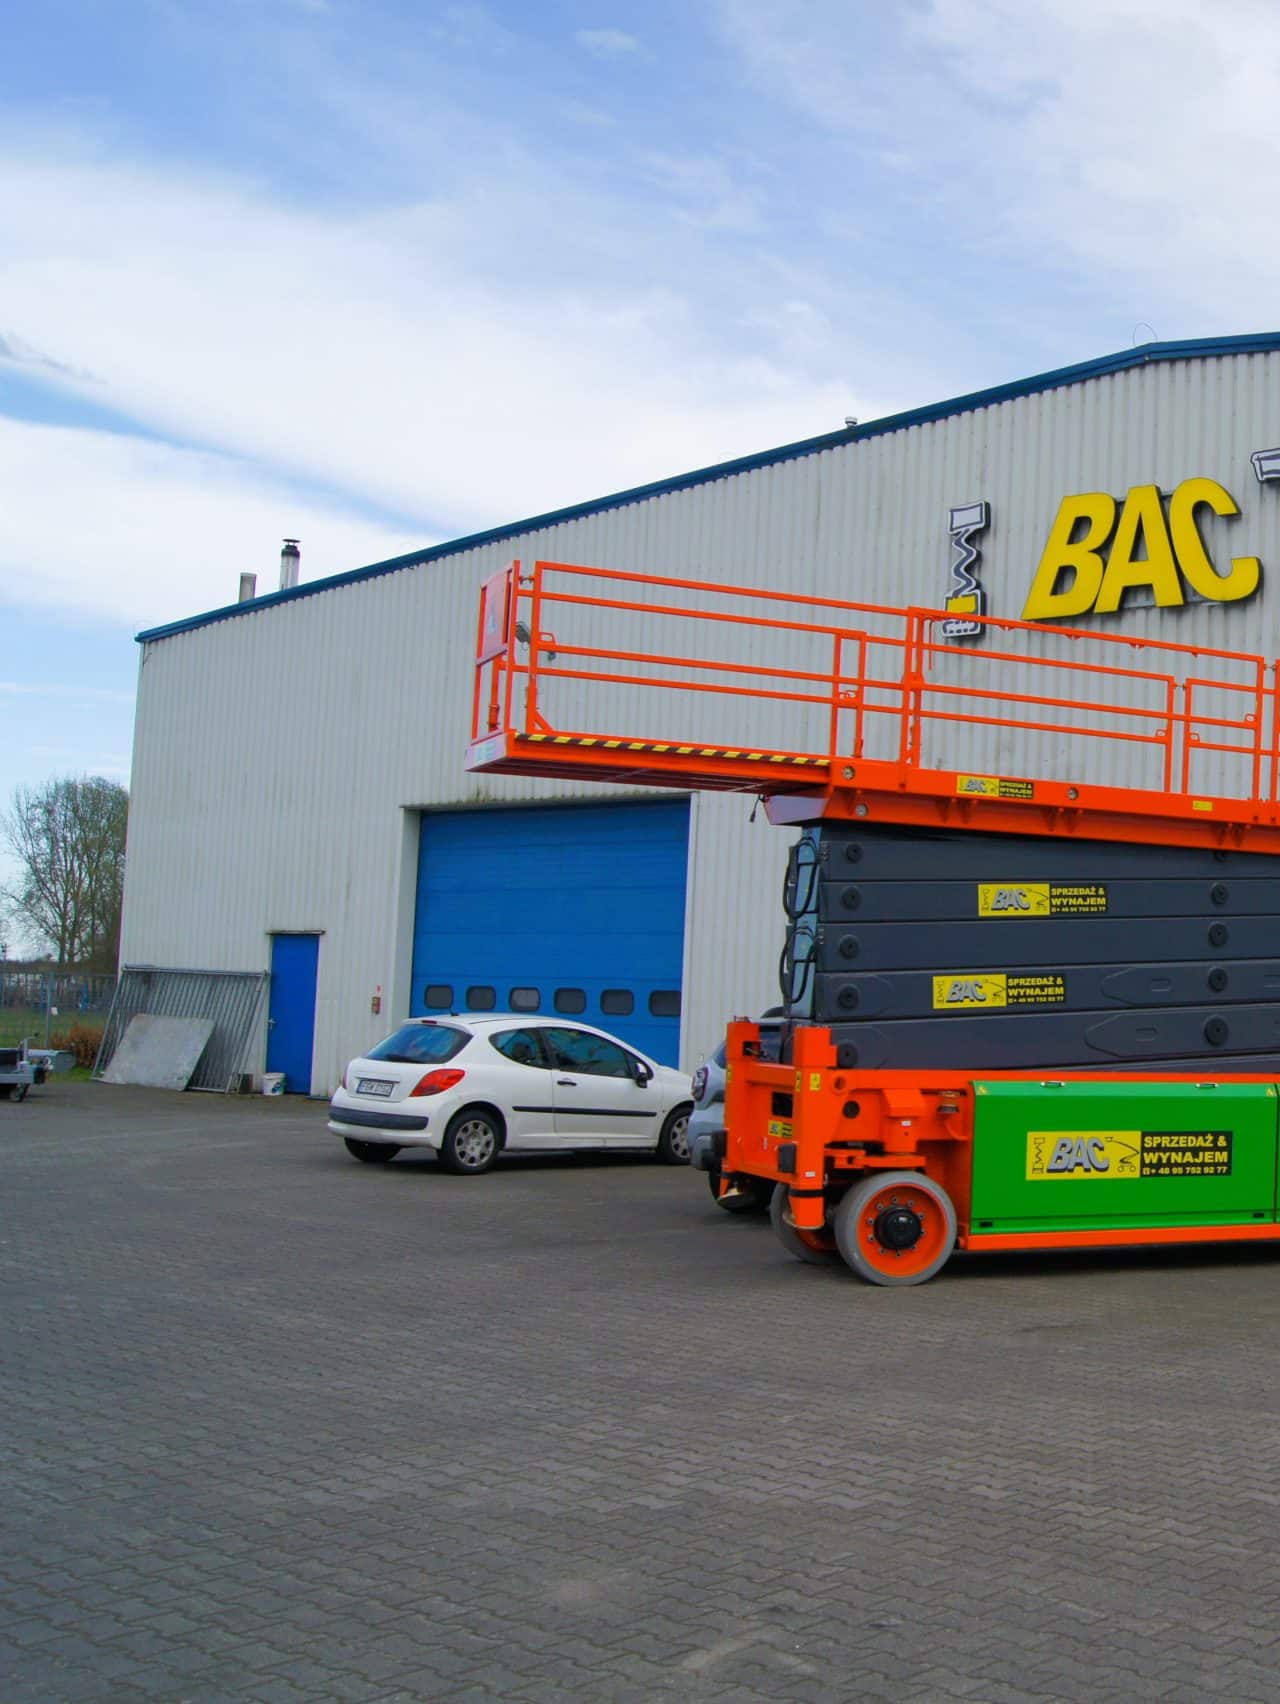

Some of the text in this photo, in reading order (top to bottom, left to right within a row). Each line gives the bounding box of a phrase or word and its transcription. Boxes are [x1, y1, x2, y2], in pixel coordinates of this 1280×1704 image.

[1021, 477, 1262, 621] BAC
[1051, 886, 1105, 896] SPRZEDAŻ &
[991, 888, 1031, 911] BAC
[1051, 897, 1106, 906] WYNAJEM
[1008, 976, 1063, 986] SPRZEDAŻ &
[946, 980, 987, 1003] BAC
[1008, 986, 1064, 996] WYNAJEM
[1144, 1133, 1227, 1147] SPRZEDAŻ &
[1046, 1136, 1110, 1173] BAC
[1143, 1151, 1228, 1164] WYNAJEM
[1216, 1166, 1228, 1174] 77
